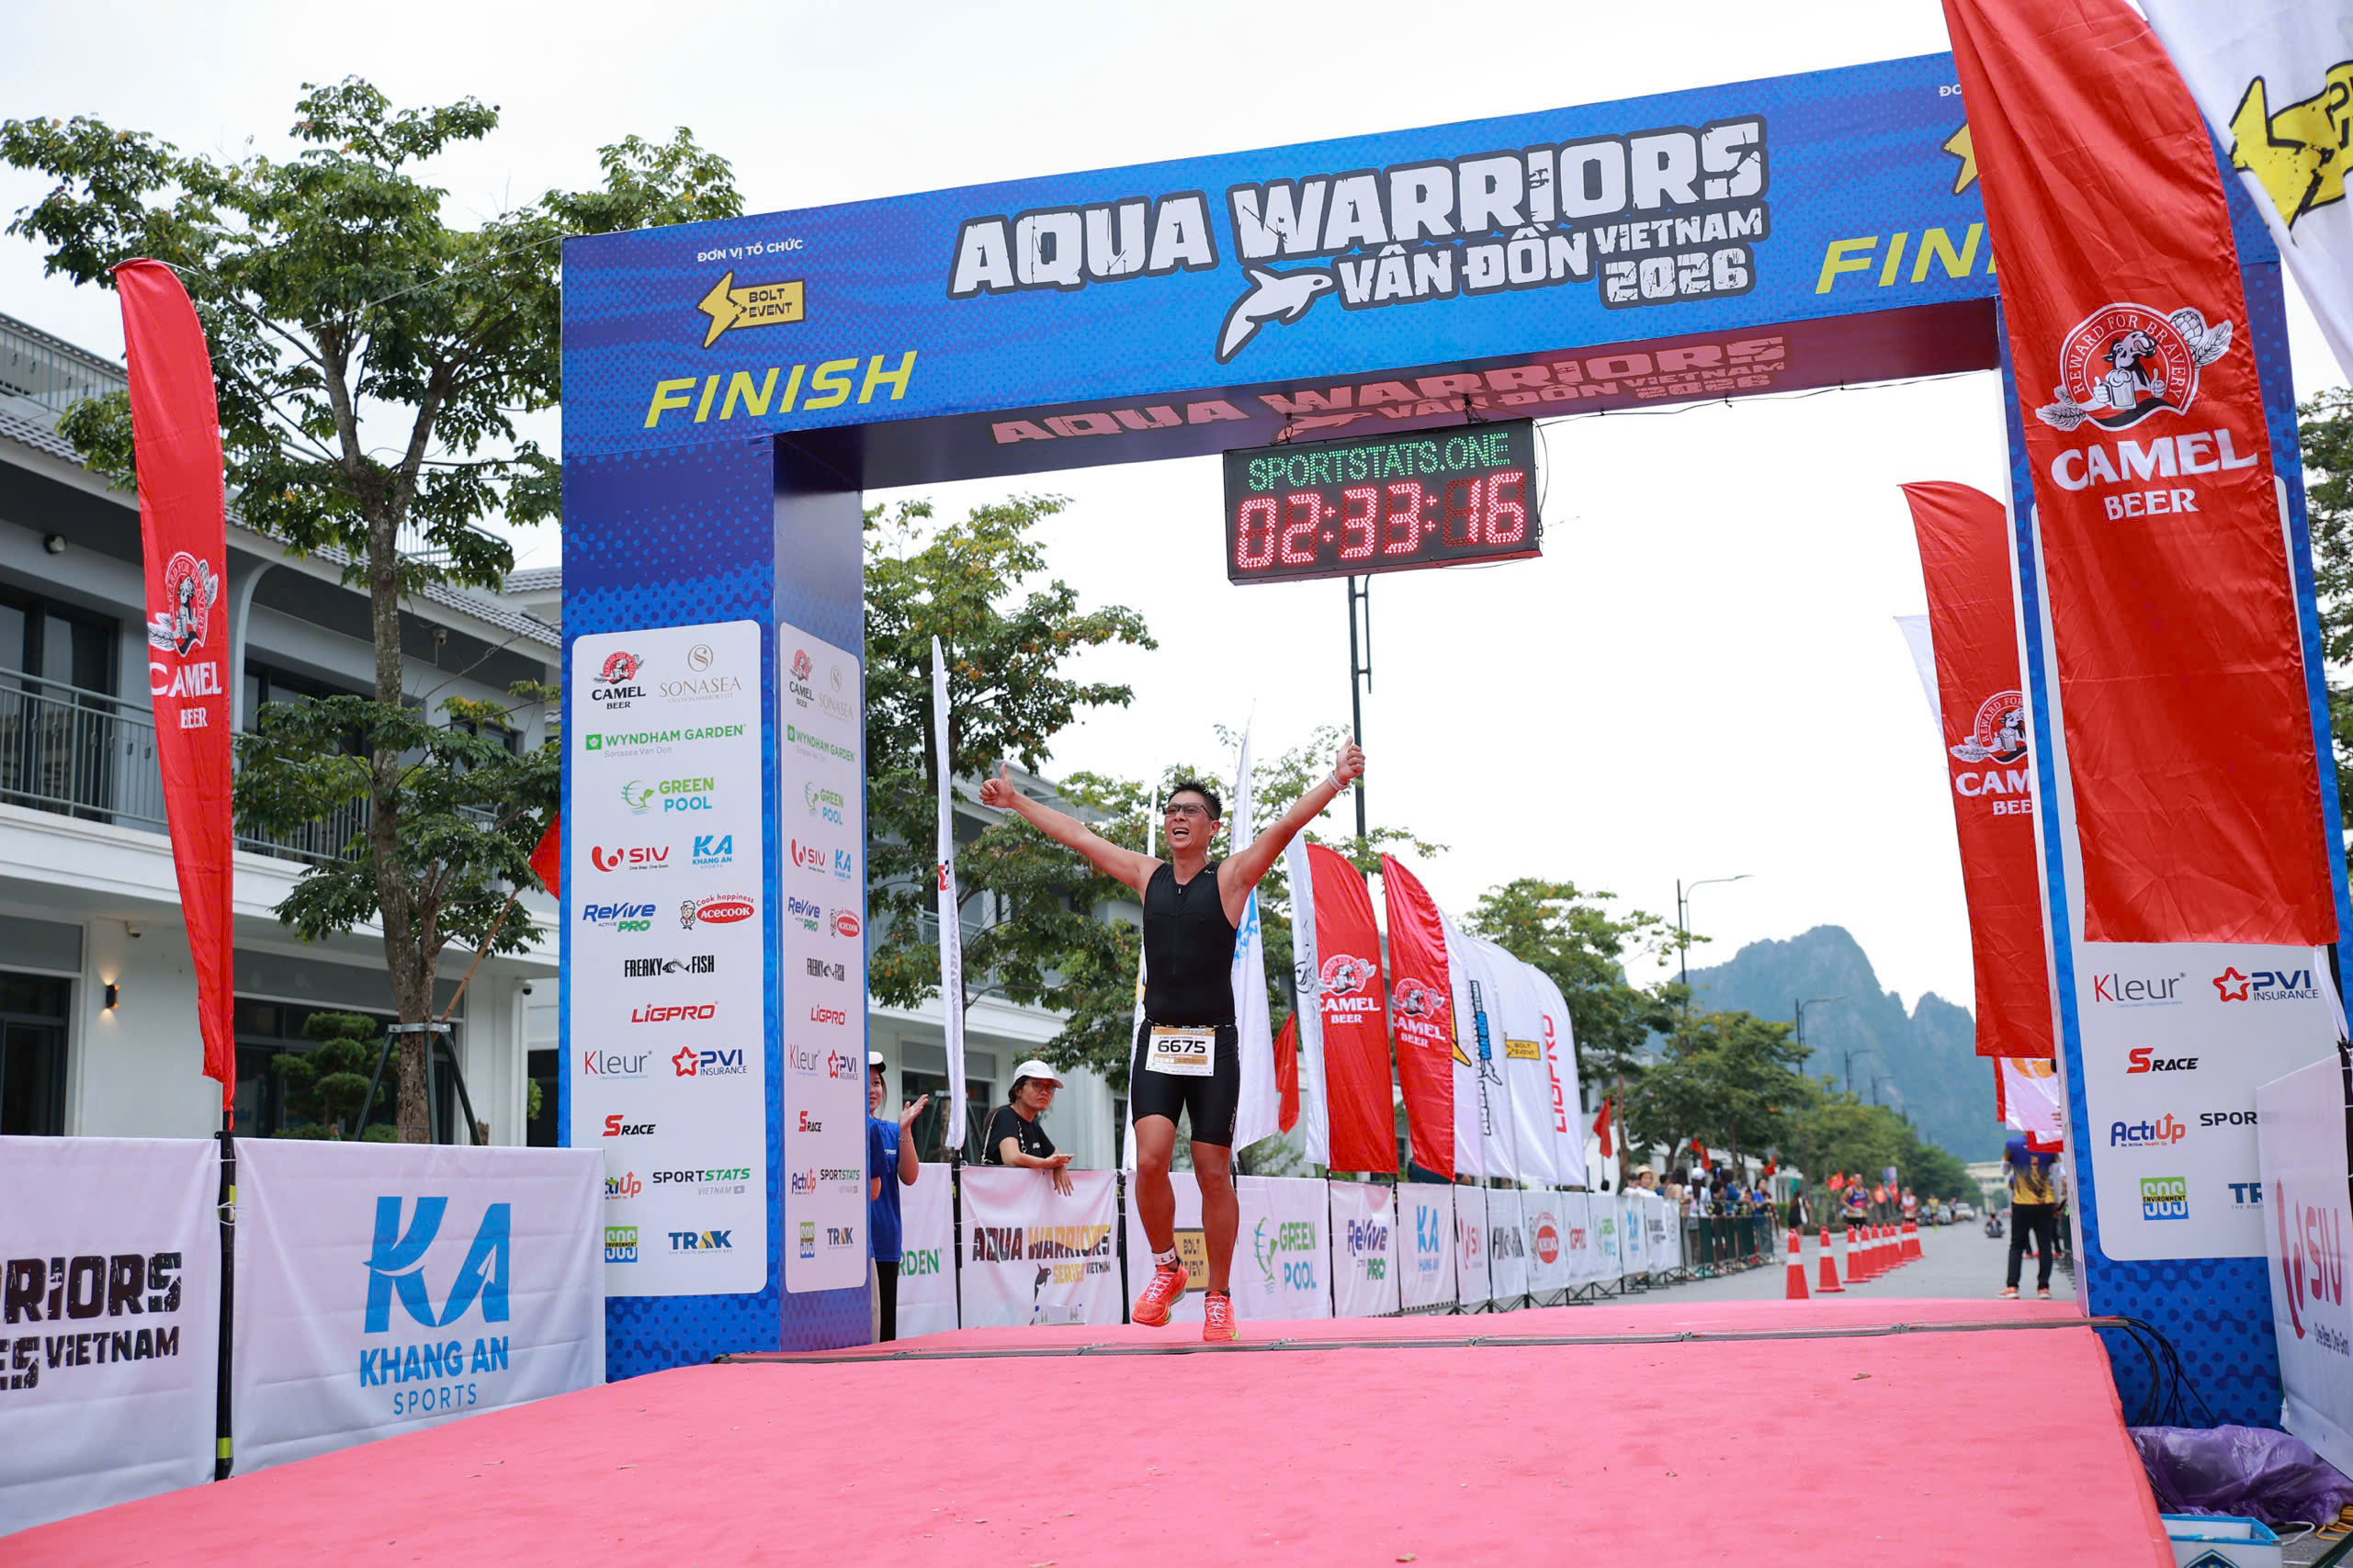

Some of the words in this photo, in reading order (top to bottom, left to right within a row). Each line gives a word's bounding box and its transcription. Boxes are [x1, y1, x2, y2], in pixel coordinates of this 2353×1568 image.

[952, 196, 1214, 295] AQUA
[1232, 121, 1763, 260] WARRIORS
[1592, 207, 1763, 254] VIETNAM
[696, 247, 728, 264] ĐƠN
[730, 246, 744, 261] VỊ
[746, 240, 764, 257] TỔ
[766, 238, 804, 254] CHỨC
[1815, 222, 1997, 295] FIN
[1338, 243, 1454, 304] VÂN
[1462, 222, 1589, 289] ĐỒN
[1605, 247, 1748, 303] 2026
[749, 288, 786, 304] BOLT
[749, 301, 793, 319] EVENT
[2069, 324, 2105, 395] REWARD
[2107, 314, 2139, 331] FOR
[2145, 321, 2186, 399] BRAVERY
[1623, 361, 1785, 388] VIETNAM
[643, 350, 919, 429] FINISH
[991, 399, 1250, 445] AQUA
[1258, 336, 1785, 414] WARRIORS
[1249, 433, 1510, 491] SPORTSTATS.ONE
[2051, 428, 2258, 491] CAMEL
[2104, 489, 2200, 521] BEER
[1238, 471, 1525, 569] 02:33:16
[150, 660, 222, 698] CAMEL
[660, 676, 741, 698] SONASEA
[592, 686, 646, 701] CAMEL
[789, 681, 814, 702] CAMEL
[181, 706, 208, 728] BEER
[606, 701, 631, 710] BEER
[605, 730, 681, 747] WYNDHAM
[684, 724, 743, 740] GARDEN
[796, 729, 830, 753] WYNDHAM
[605, 748, 638, 758] Sonasea
[659, 777, 715, 795] GREEN
[1955, 771, 2032, 796] CAM
[664, 796, 713, 813] POOL
[820, 788, 843, 809] GREEN
[1993, 799, 2033, 816] BEE
[823, 807, 843, 826] POOL
[629, 846, 670, 863] SIV
[693, 835, 733, 857] KA
[808, 849, 826, 866] SIV
[834, 848, 852, 873] KA
[696, 895, 716, 907] Cook
[717, 893, 755, 905] happiness
[617, 919, 651, 933] PRO
[624, 958, 663, 977] FREAKY
[692, 955, 715, 974] FISH
[2094, 973, 2179, 1003] Kleur
[2252, 969, 2312, 991] PVI
[2254, 988, 2319, 1001] INSURANCE
[1330, 1014, 1363, 1025] BEER
[1158, 1040, 1205, 1054] 6675
[1400, 1032, 1430, 1049] BEER
[585, 1050, 649, 1076] Kleur
[700, 1049, 743, 1067] PVI
[790, 1044, 818, 1071] Kleur
[840, 1056, 857, 1073] PVI
[700, 1066, 747, 1077] INSURANCE
[2110, 1112, 2185, 1147] ActiUp
[652, 1168, 751, 1184] SPORTSTATS
[2143, 1194, 2186, 1202] ENVIRONMENT
[2228, 1183, 2263, 1203] TR
[1279, 1222, 1316, 1251] GREEN
[1417, 1205, 1440, 1253] KA
[972, 1226, 1023, 1263] AQUA
[1028, 1224, 1111, 1260] WARRIORS
[362, 1195, 512, 1334] KA
[2306, 1206, 2342, 1306] SIV
[1284, 1261, 1317, 1292] POOL
[1367, 1258, 1386, 1280] PRO
[0, 1252, 182, 1325] RIORS
[46, 1325, 179, 1369] VIETNAM
[360, 1339, 463, 1388] KHANG
[471, 1336, 509, 1375] AN
[394, 1383, 477, 1416] SPORTS
